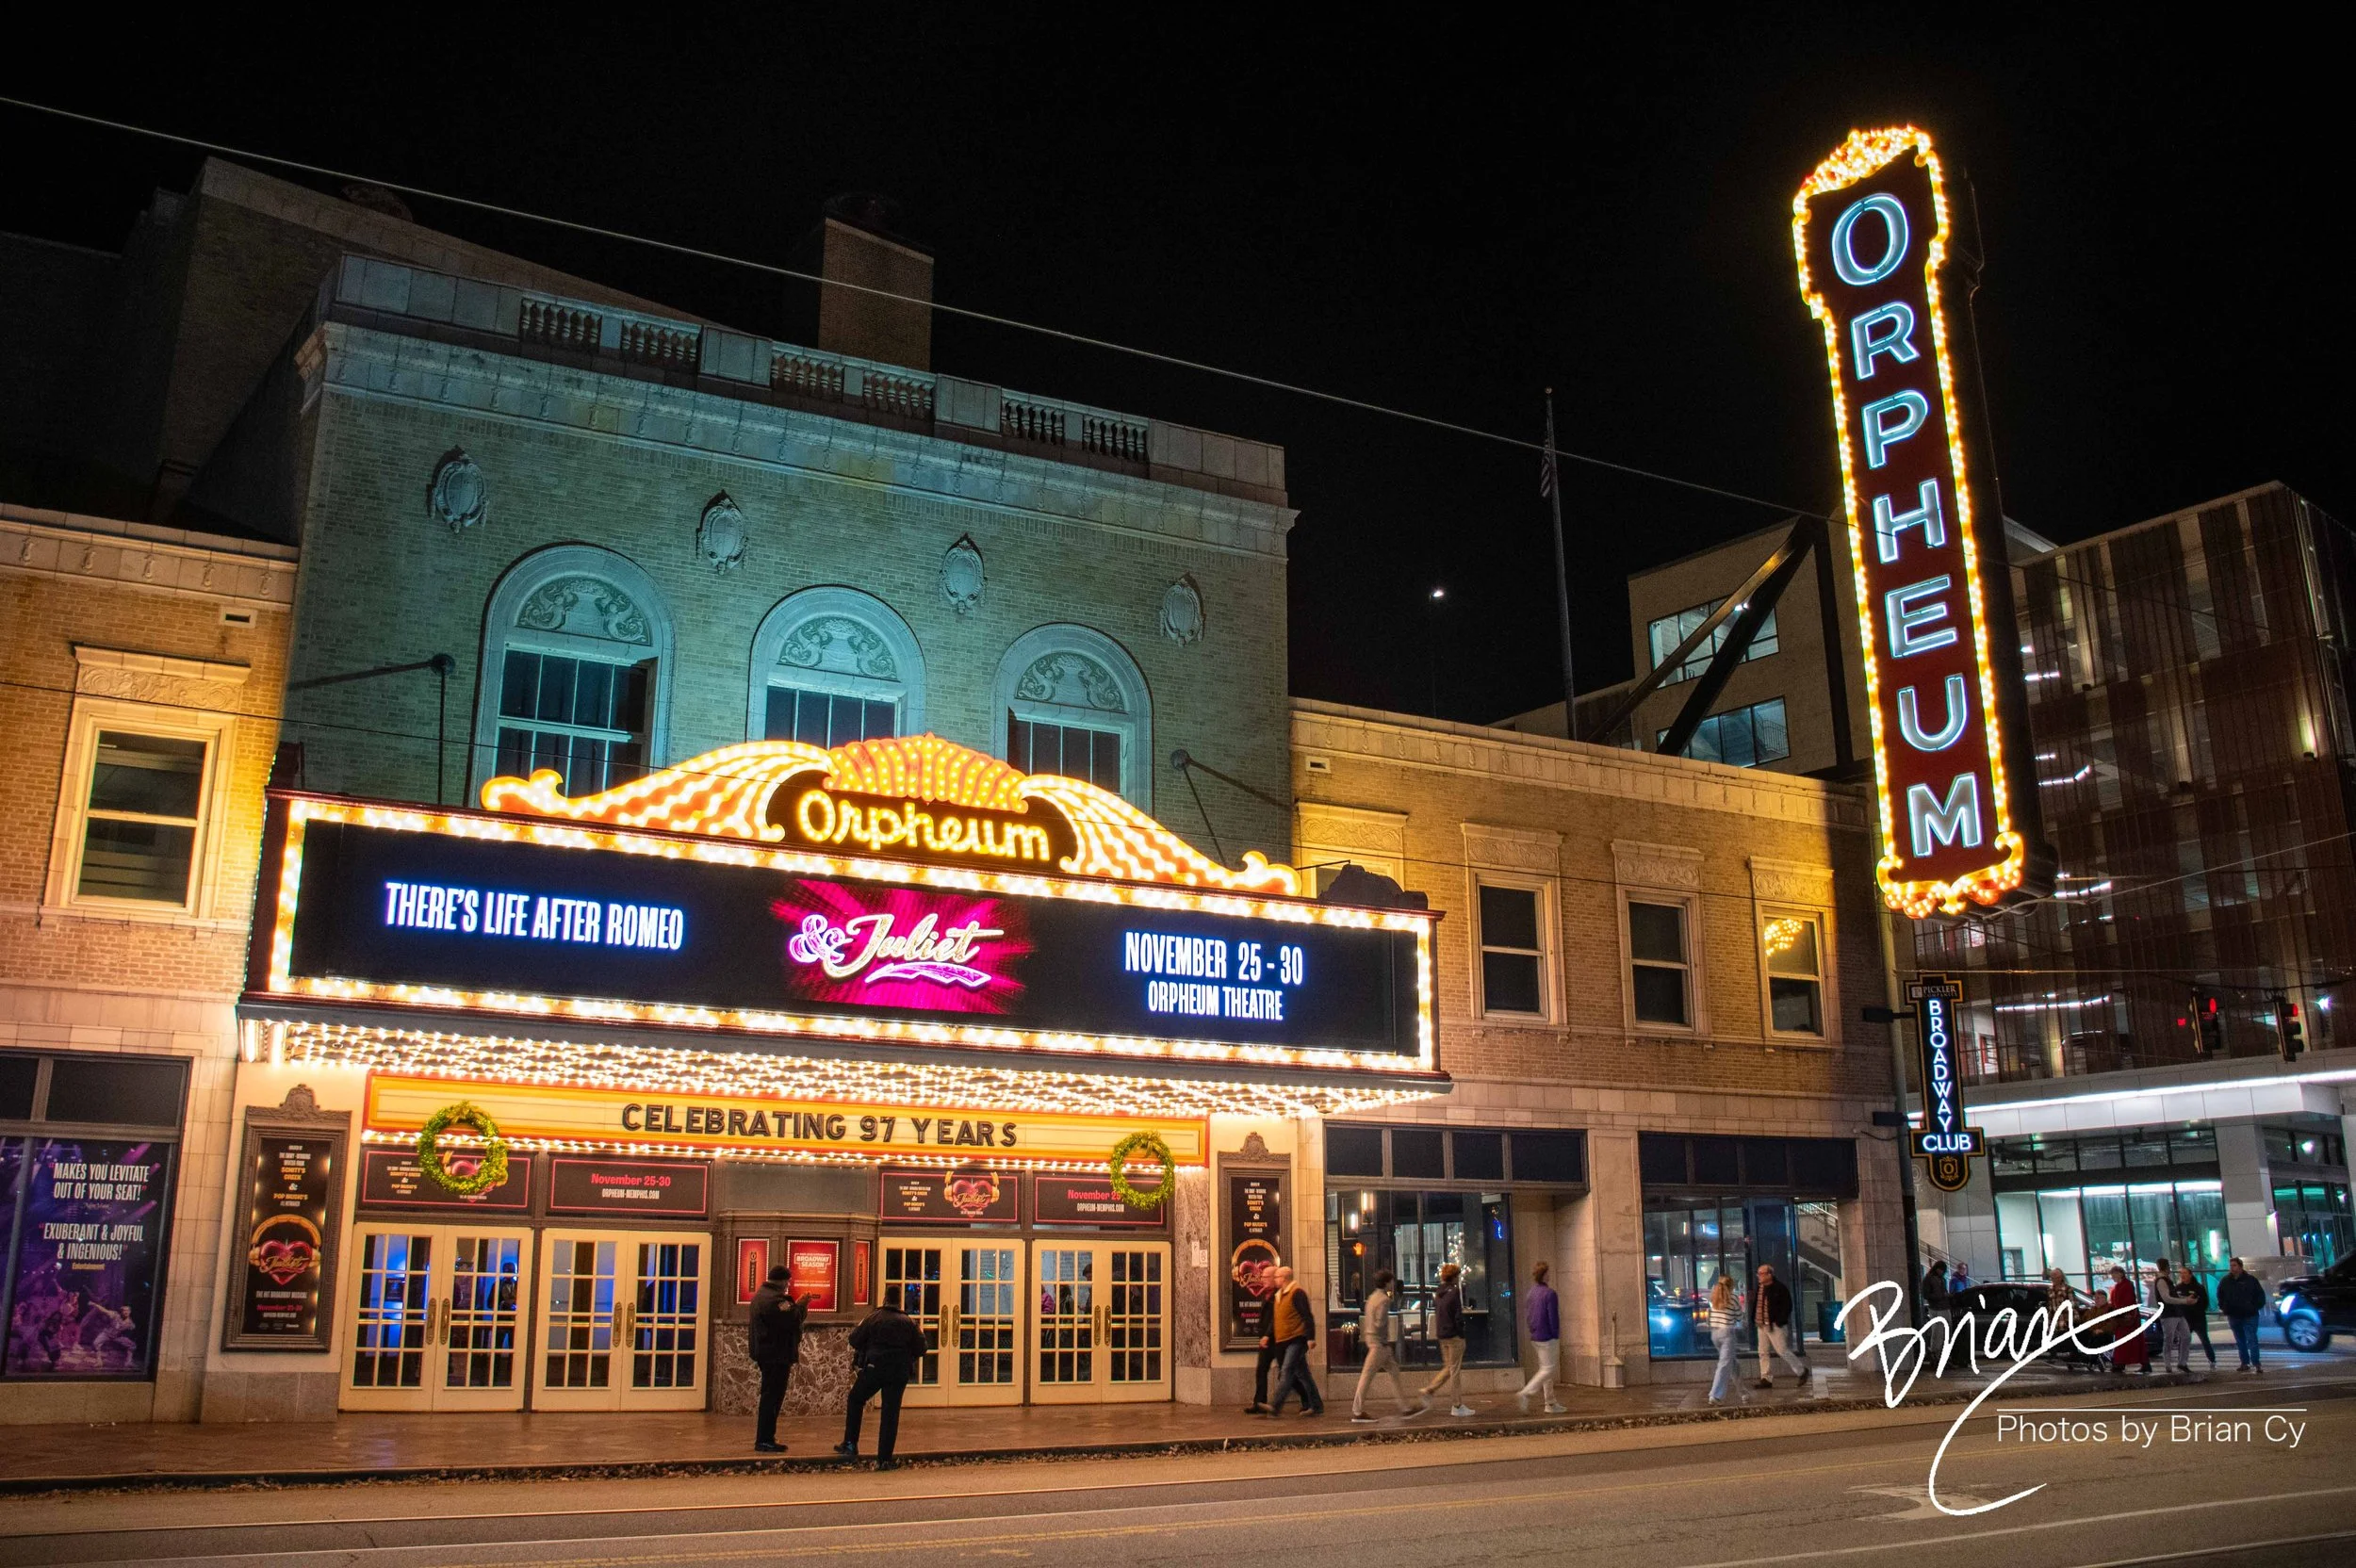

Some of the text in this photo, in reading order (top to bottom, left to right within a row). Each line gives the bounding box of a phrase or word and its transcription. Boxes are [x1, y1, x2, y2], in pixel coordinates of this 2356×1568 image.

[1830, 193, 1982, 858] ORPHEUM
[798, 790, 1050, 861] Orpheum
[385, 882, 683, 950] THERE'S LIFE AFTER ROMEO
[823, 912, 1005, 978] Juliet
[1125, 931, 1227, 979] NOVEMBER
[1148, 980, 1284, 1021] ORPHEUM THEATRE
[1922, 985, 1956, 994] PICKLER
[1928, 1000, 1952, 1133] BROADWAY
[622, 1102, 1017, 1148] CELEBRATING 97 YEARS
[1922, 1134, 1972, 1152] CLUB
[90, 1164, 108, 1181] YOU
[109, 1165, 150, 1183] LEVITATE
[591, 1173, 671, 1187] November 25-30
[54, 1182, 74, 1199] OUT
[74, 1183, 87, 1200] OF
[90, 1183, 113, 1200] YOUR
[1068, 1189, 1109, 1200] November
[101, 1224, 108, 1240] &
[110, 1225, 143, 1242] JOYFUL
[57, 1243, 64, 1259] &
